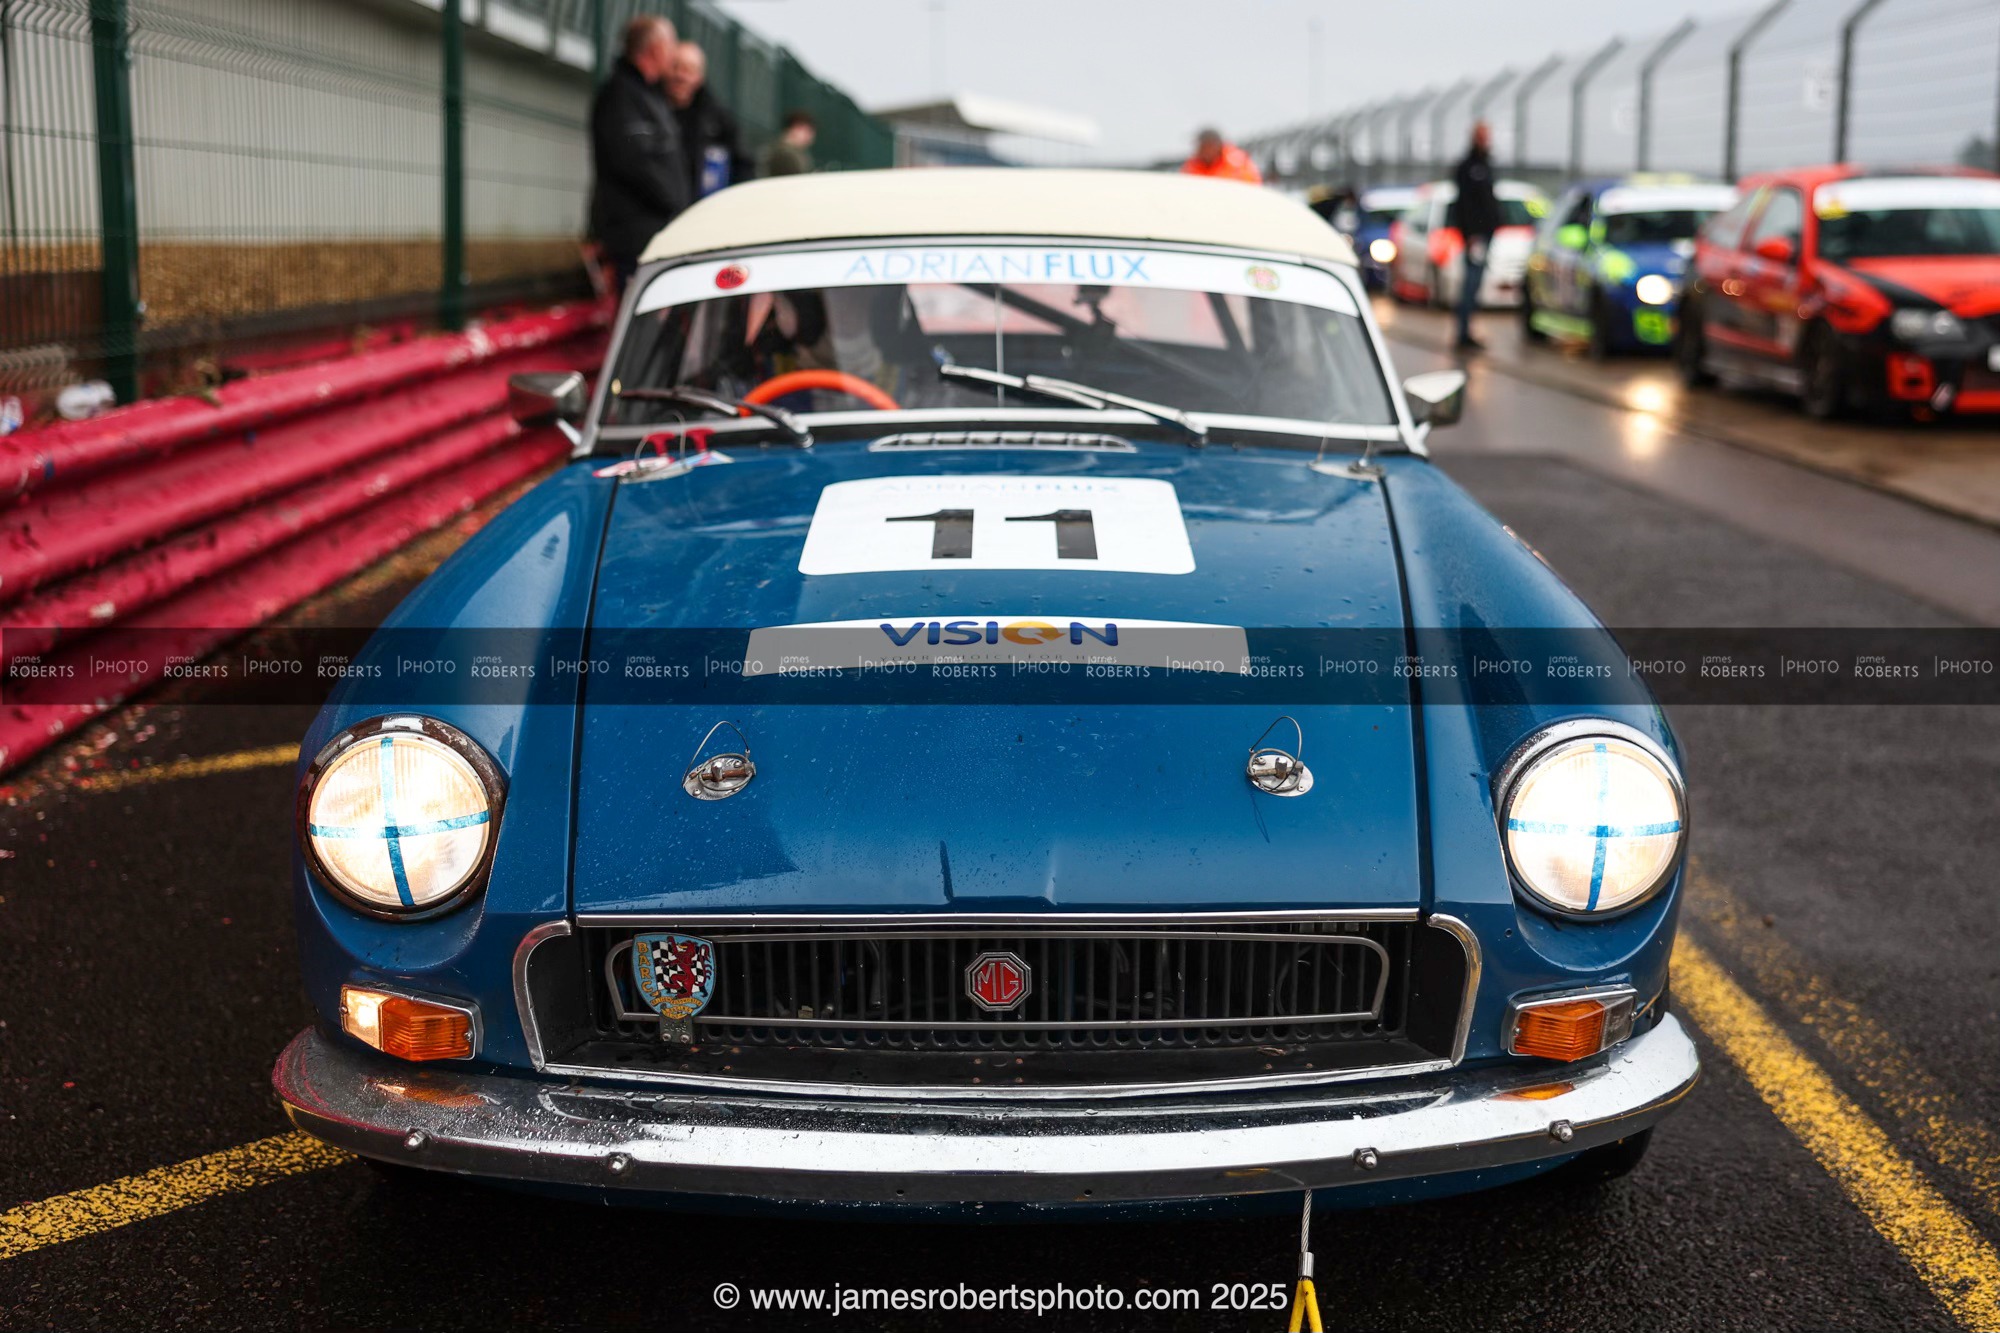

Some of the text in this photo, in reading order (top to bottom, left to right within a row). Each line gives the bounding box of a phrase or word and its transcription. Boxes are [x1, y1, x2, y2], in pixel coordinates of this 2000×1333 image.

[885, 508, 1099, 560] 11
[879, 620, 1119, 647] VISION
[636, 942, 653, 993] BARC
[977, 962, 1020, 1001] MG
